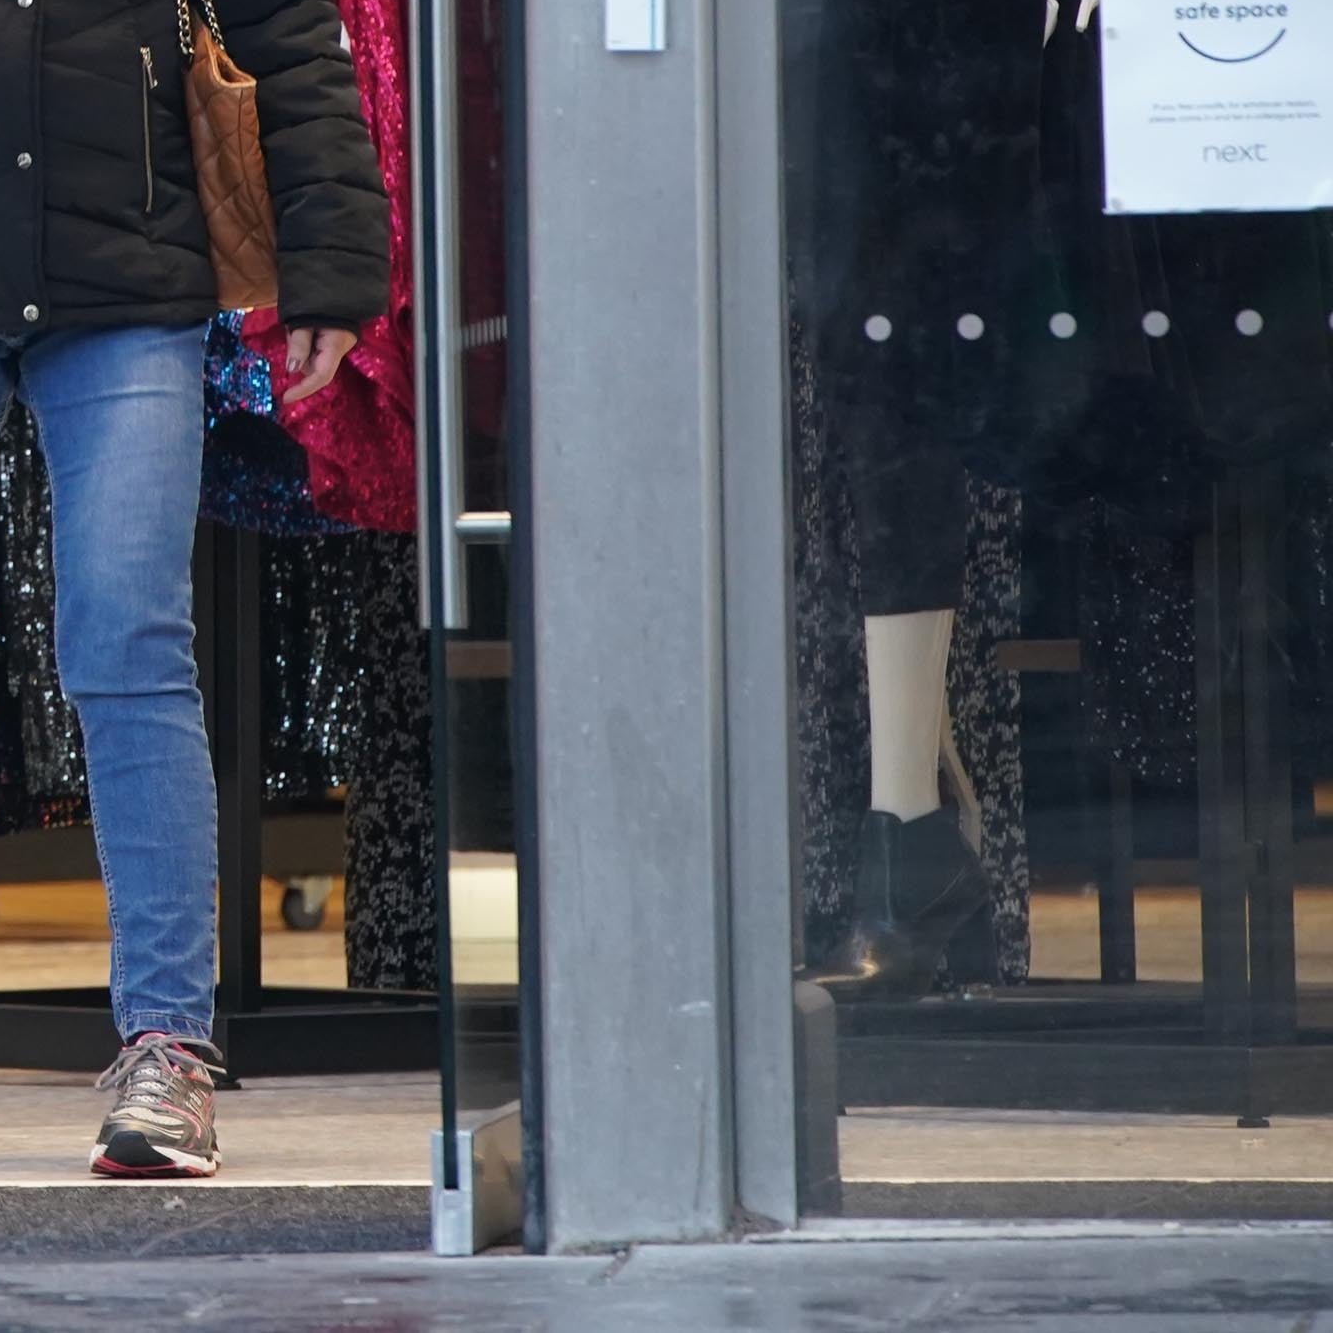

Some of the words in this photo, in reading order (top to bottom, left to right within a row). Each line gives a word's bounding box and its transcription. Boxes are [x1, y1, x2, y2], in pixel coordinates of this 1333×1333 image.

[1175, 2, 1220, 20] safe
[1225, 4, 1288, 22] space
[1202, 143, 1269, 163] next
